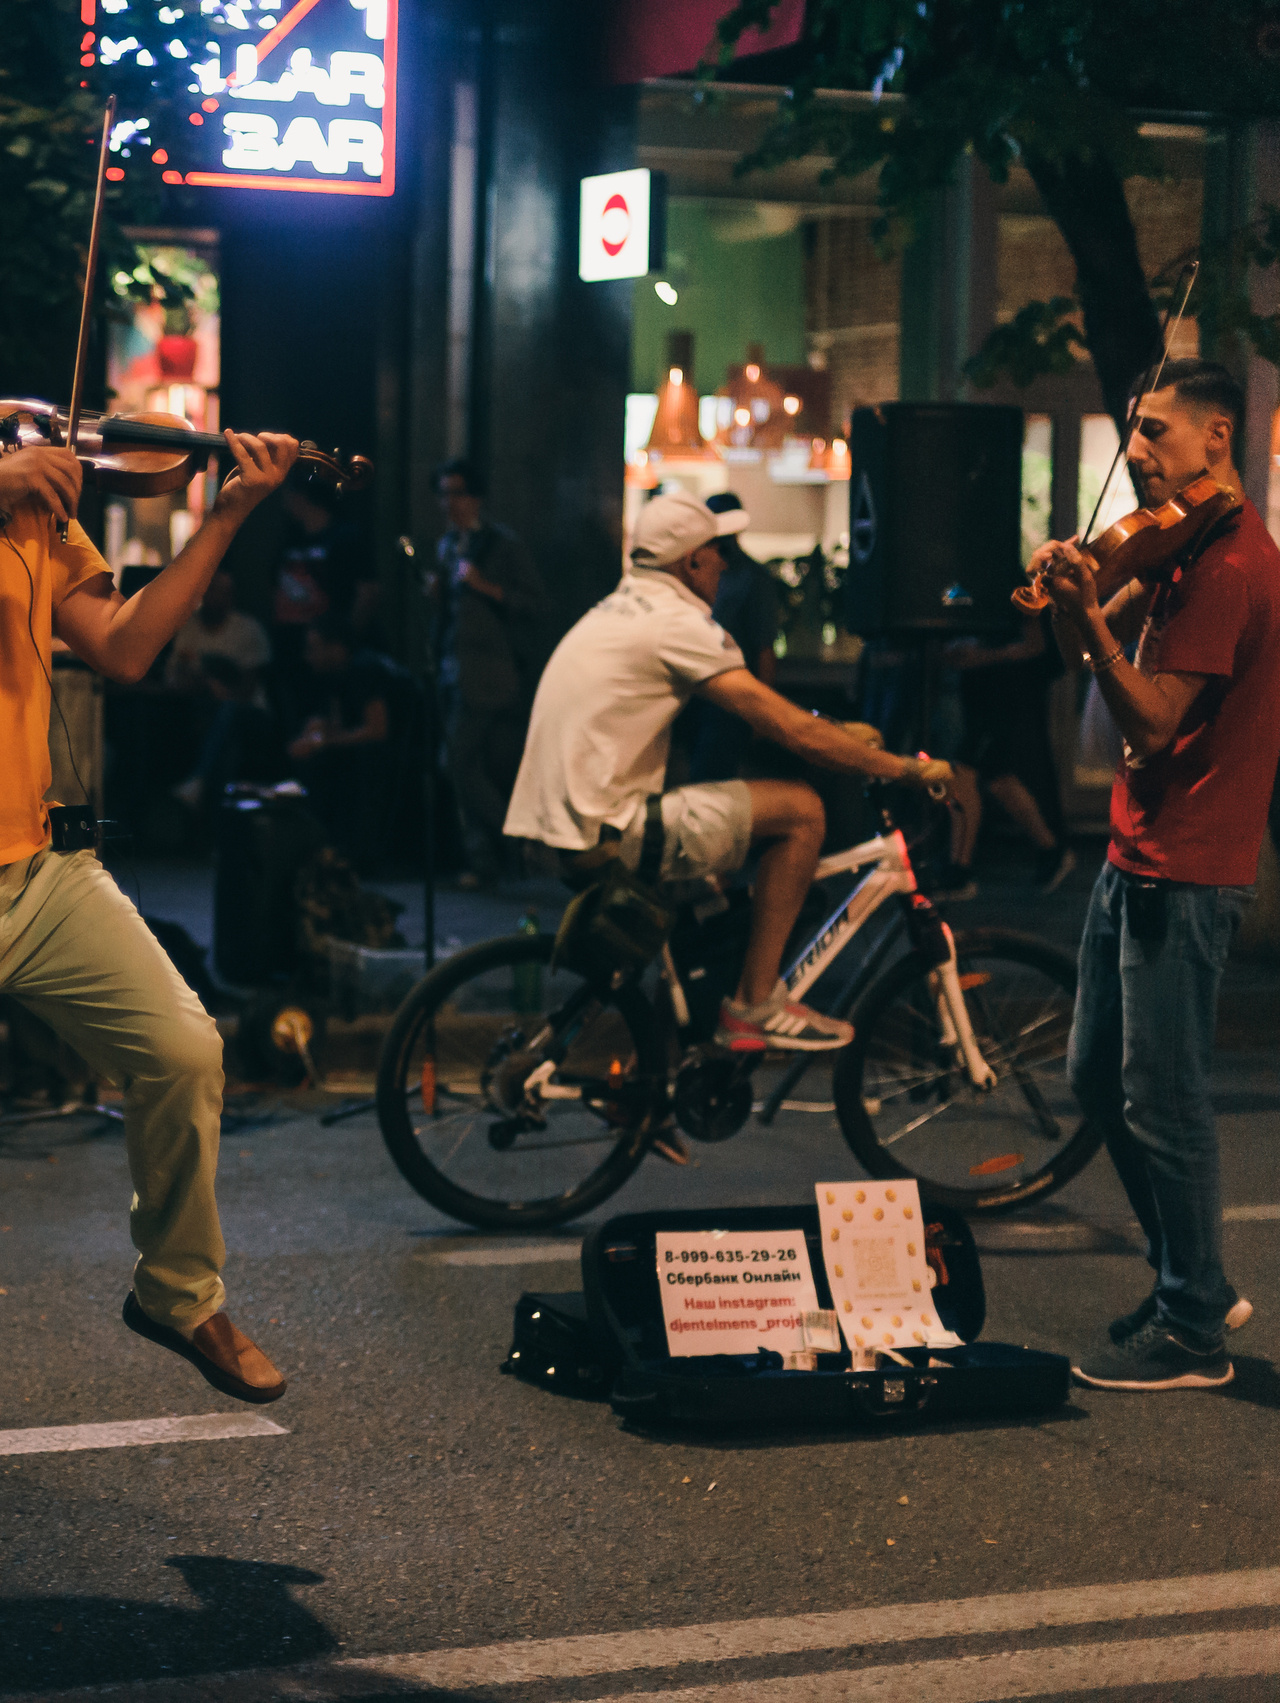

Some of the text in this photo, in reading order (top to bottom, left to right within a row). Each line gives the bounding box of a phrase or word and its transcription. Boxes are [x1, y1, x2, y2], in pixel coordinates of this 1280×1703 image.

[222, 111, 384, 177] BAR
[666, 1269, 801, 1287] Сбербанк Онлайн
[684, 1297, 716, 1309] Наш
